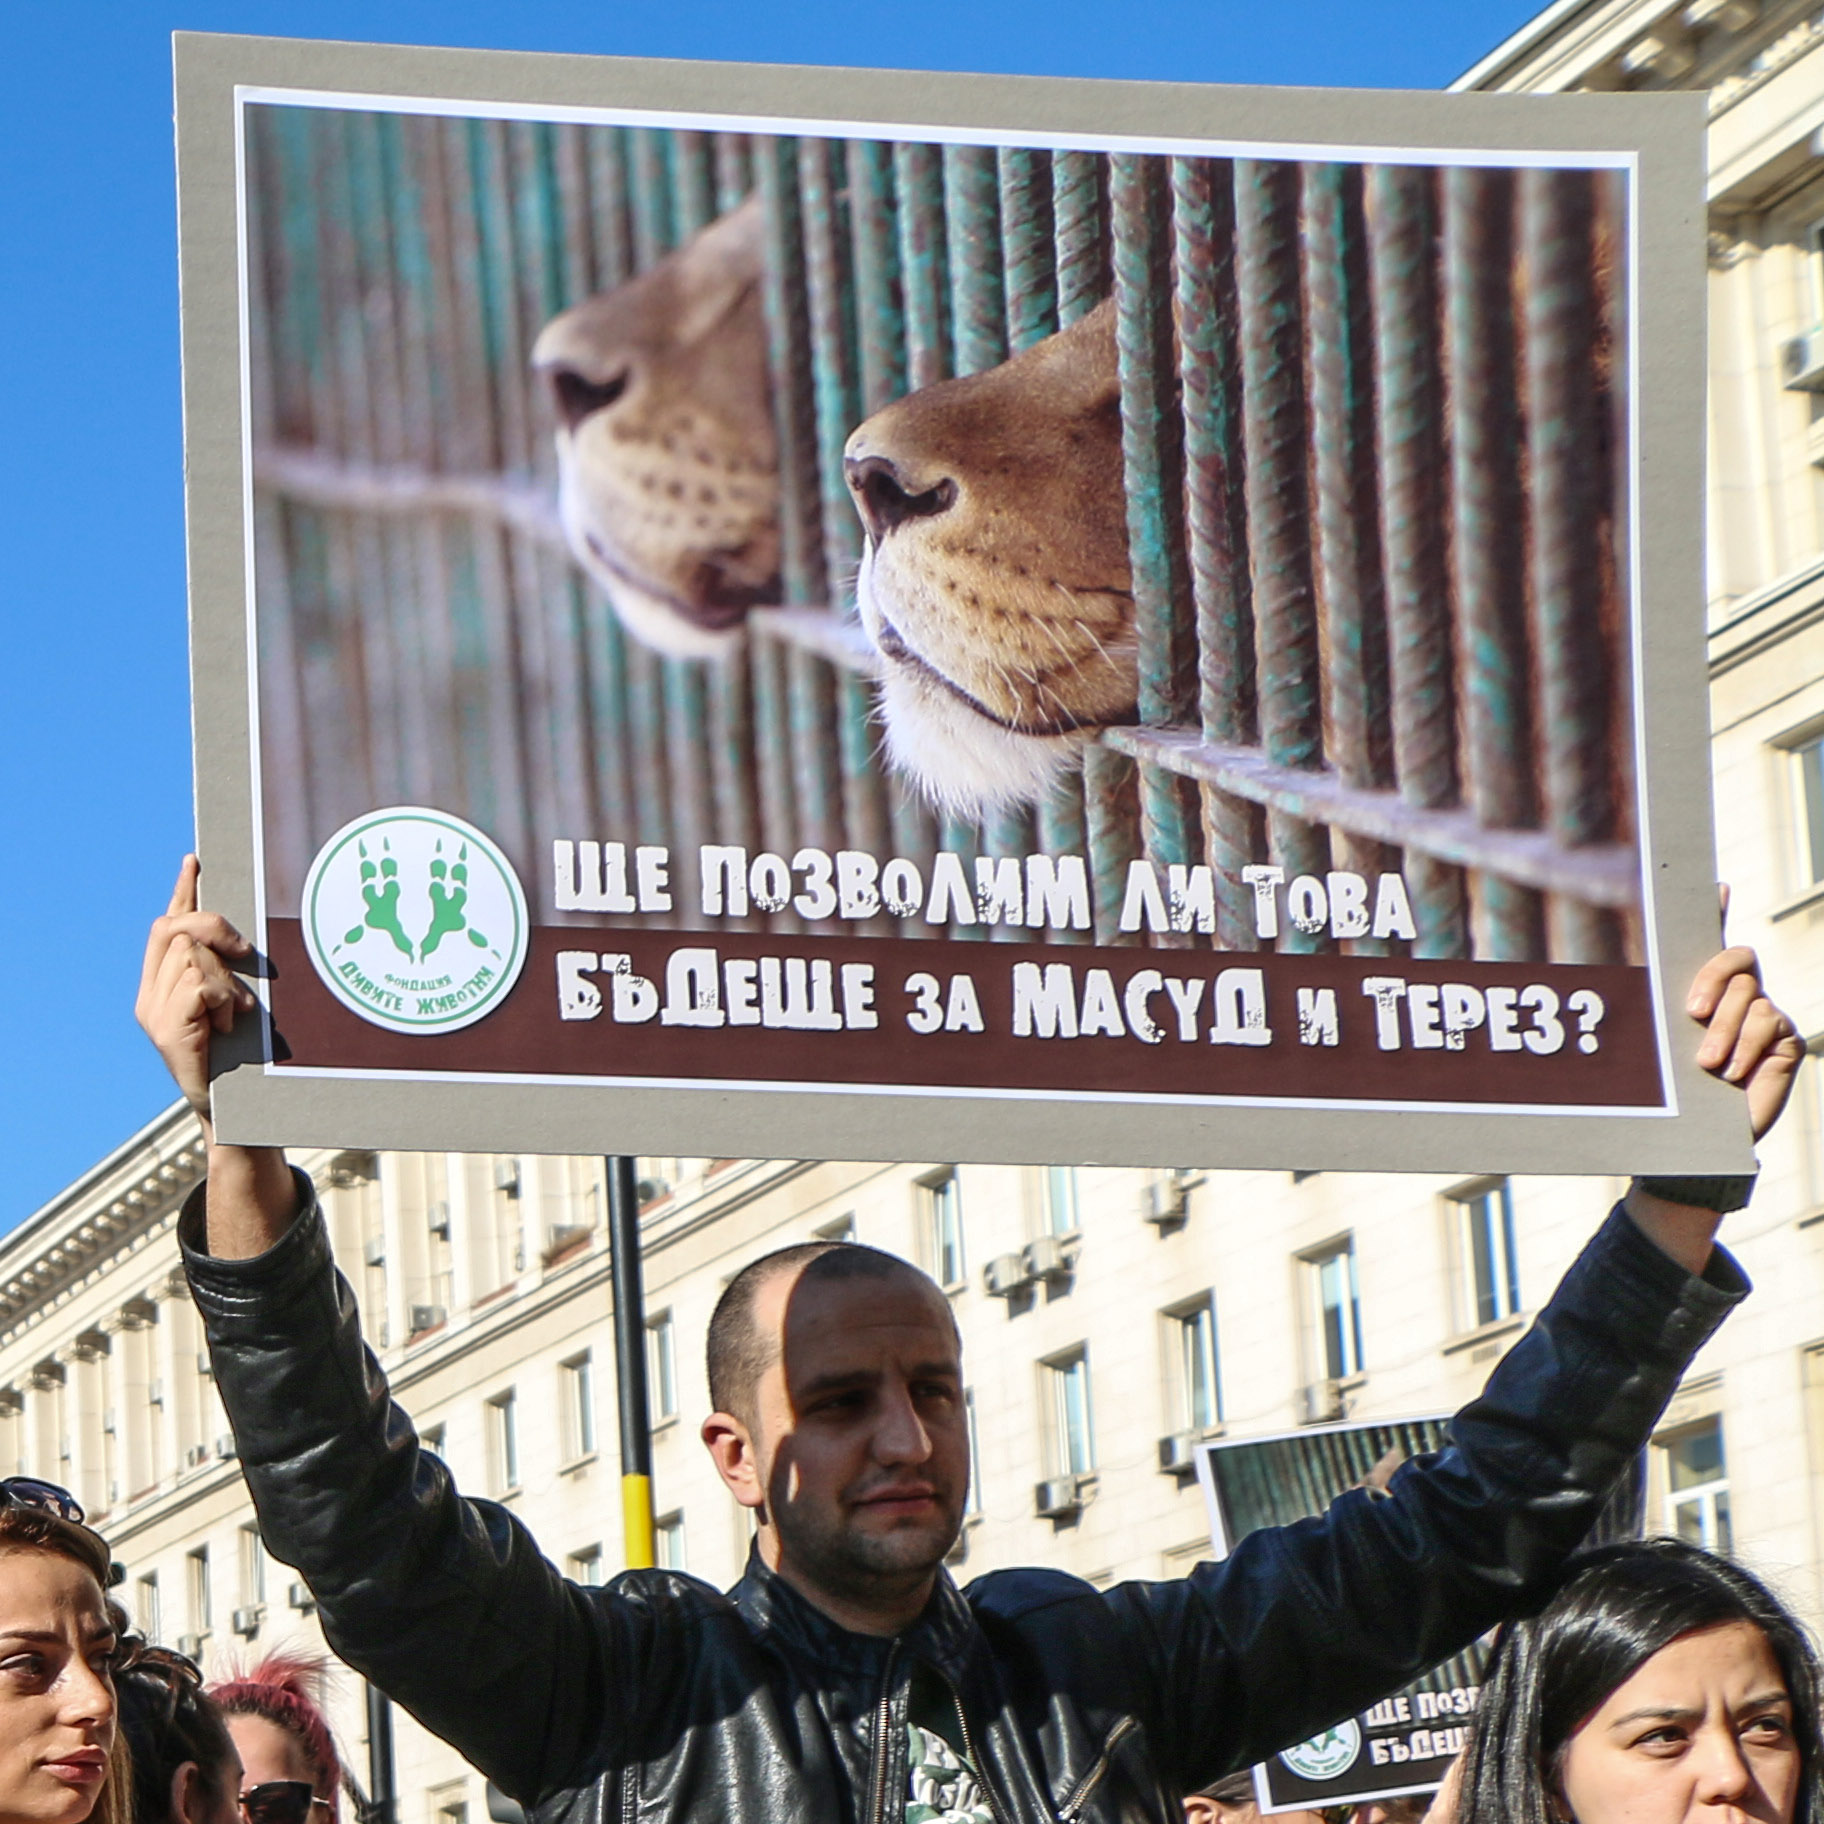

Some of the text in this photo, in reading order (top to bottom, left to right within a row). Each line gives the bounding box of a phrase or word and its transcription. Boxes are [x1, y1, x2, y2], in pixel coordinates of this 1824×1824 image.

[553, 840, 1418, 940] ЩЕ ПОЗВОЛИМ ЛИ ТОВА
[338, 960, 496, 1016] ДИВИТЕ ЖИВОТНИ
[555, 946, 880, 1032] БЪДЕЩЕ
[903, 972, 986, 1035] ЗА
[1011, 961, 1273, 1047] МАСУД
[1361, 976, 1606, 1056] ТЕРЕЗ?
